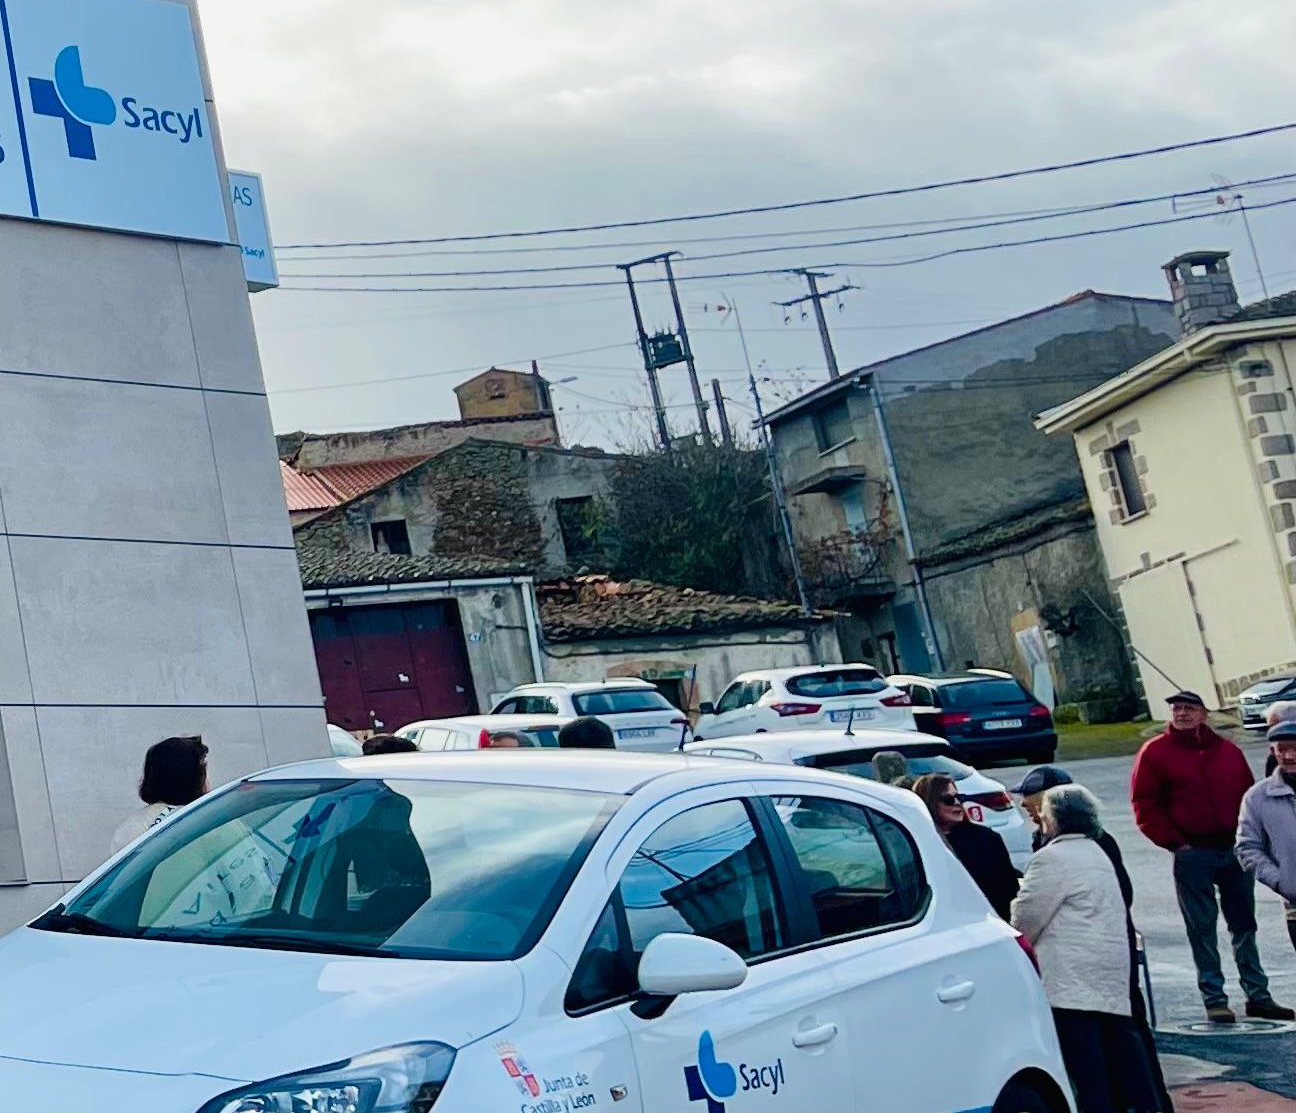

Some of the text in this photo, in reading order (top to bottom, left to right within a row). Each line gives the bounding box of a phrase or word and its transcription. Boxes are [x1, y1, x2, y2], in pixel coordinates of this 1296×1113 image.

[120, 96, 203, 145] Sacyl
[542, 1072, 589, 1093] Junta de
[739, 1057, 785, 1095] Sacyl
[520, 1098, 562, 1113] Castilla
[568, 1092, 597, 1109] León
